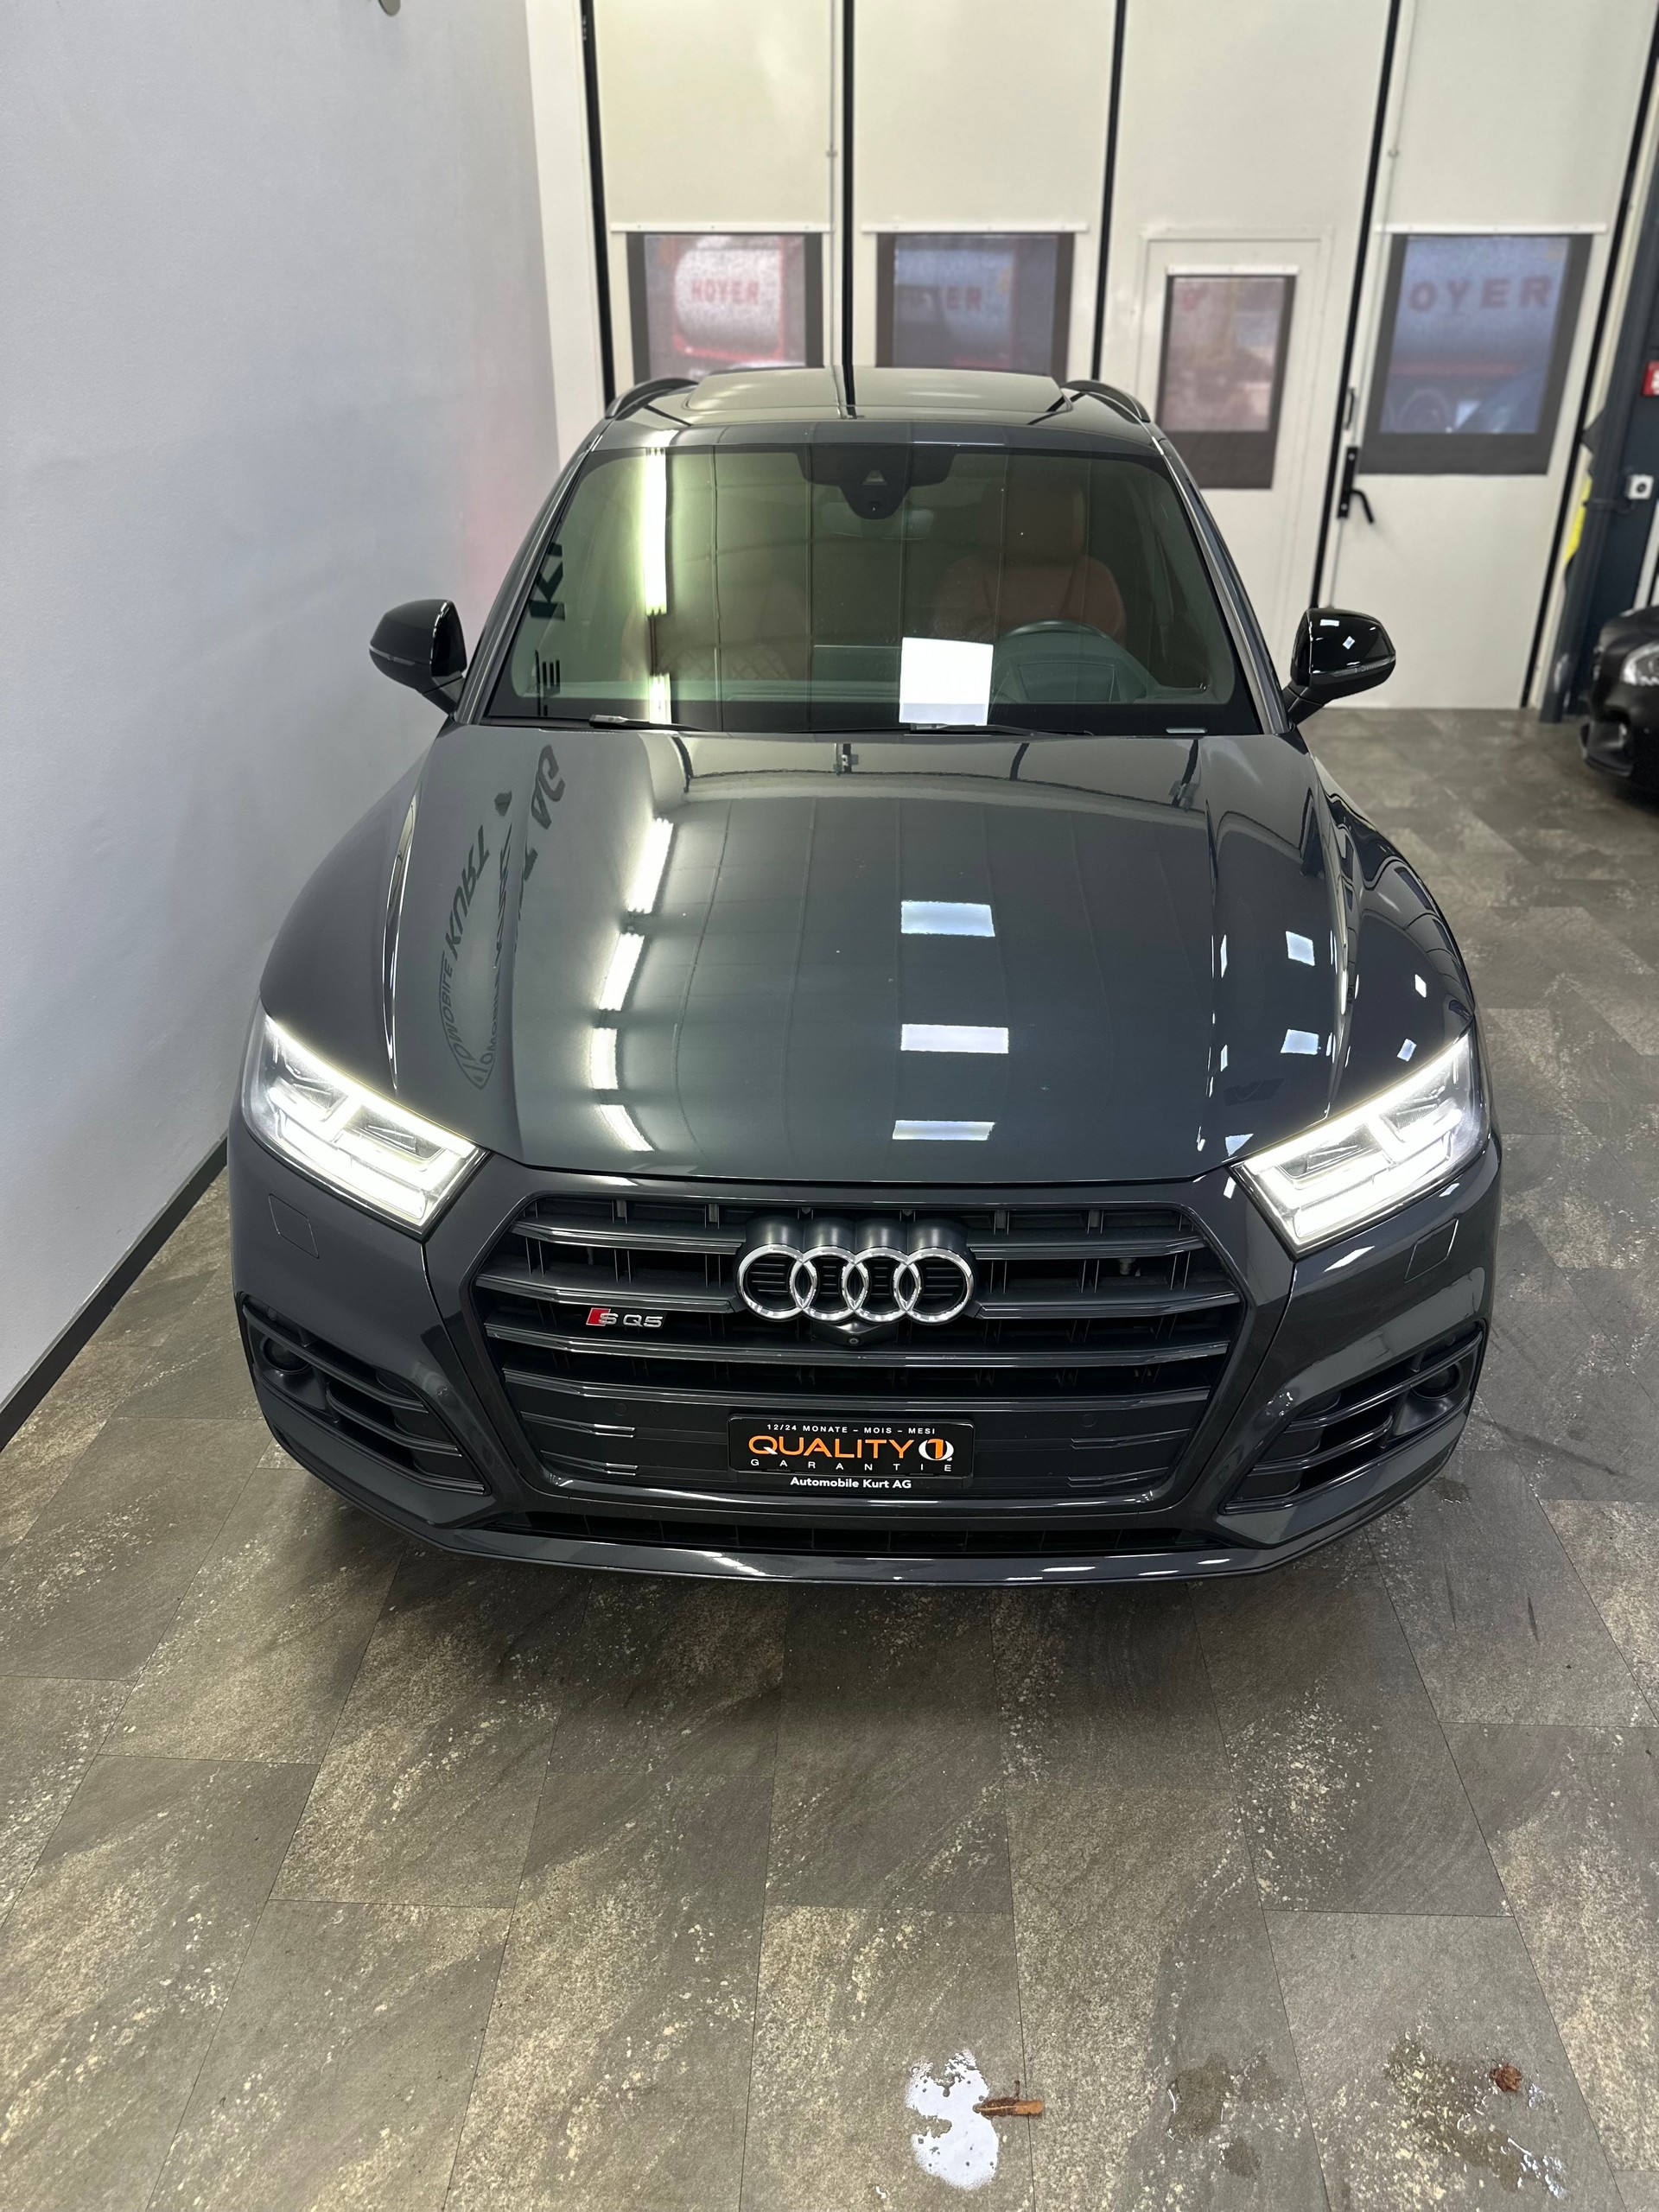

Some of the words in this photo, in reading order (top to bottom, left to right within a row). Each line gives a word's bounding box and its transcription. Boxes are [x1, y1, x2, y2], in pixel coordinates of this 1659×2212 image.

[690, 277, 760, 304] HOYER
[803, 1425, 849, 1433] MONATE
[748, 1435, 915, 1459] QUALITY
[790, 1477, 861, 1488] Automobile
[862, 1478, 889, 1489] Kurt
[892, 1480, 912, 1490] AG
